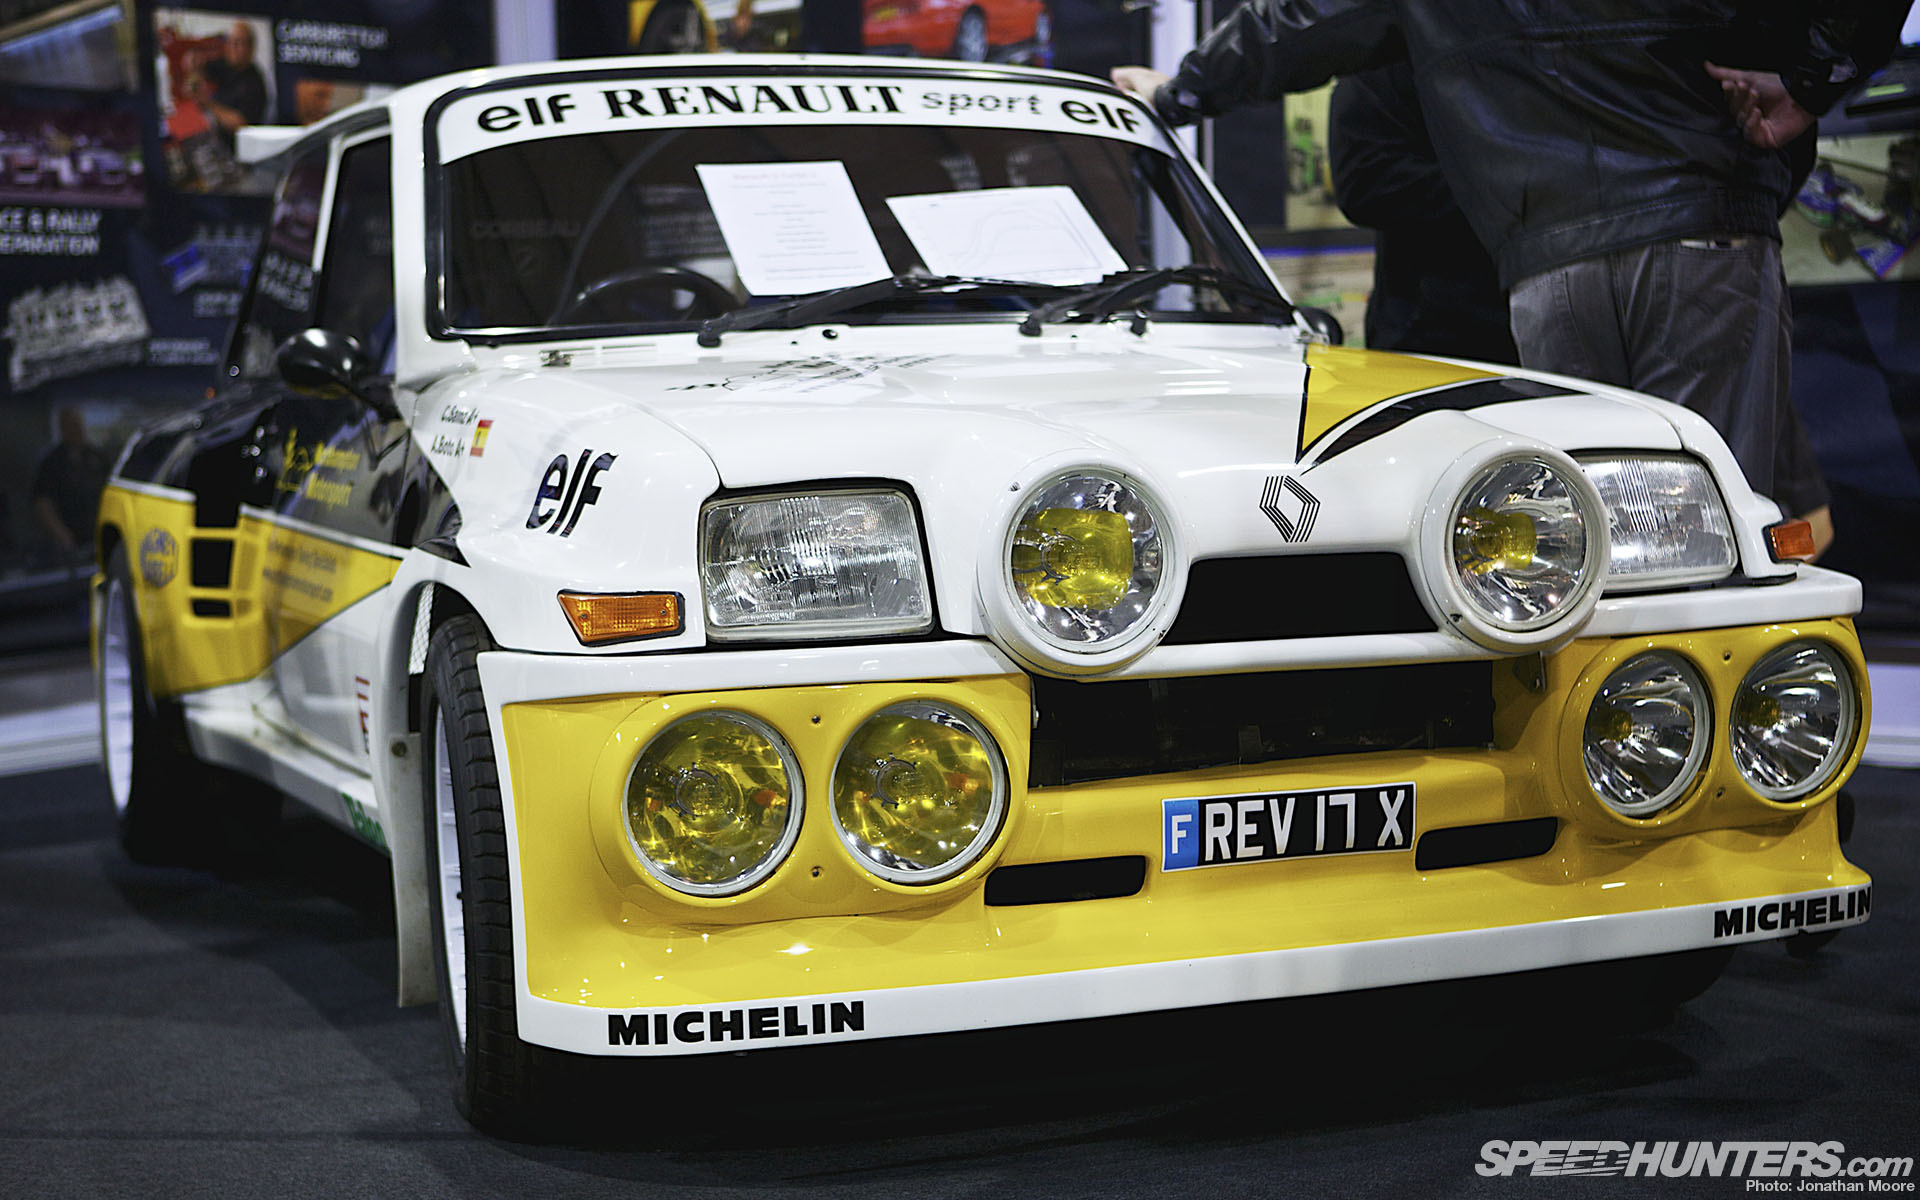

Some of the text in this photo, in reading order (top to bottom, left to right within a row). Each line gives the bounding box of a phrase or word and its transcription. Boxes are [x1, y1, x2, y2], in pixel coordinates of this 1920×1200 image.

[478, 94, 576, 132] elf
[601, 85, 906, 119] RENAULT
[921, 92, 1043, 115] sport
[1060, 99, 1144, 134] elf
[526, 449, 619, 538] elf
[1171, 789, 1406, 861] F REV 17 X
[1714, 887, 1872, 938] MICHELIN
[608, 1000, 865, 1045] MICHELIN
